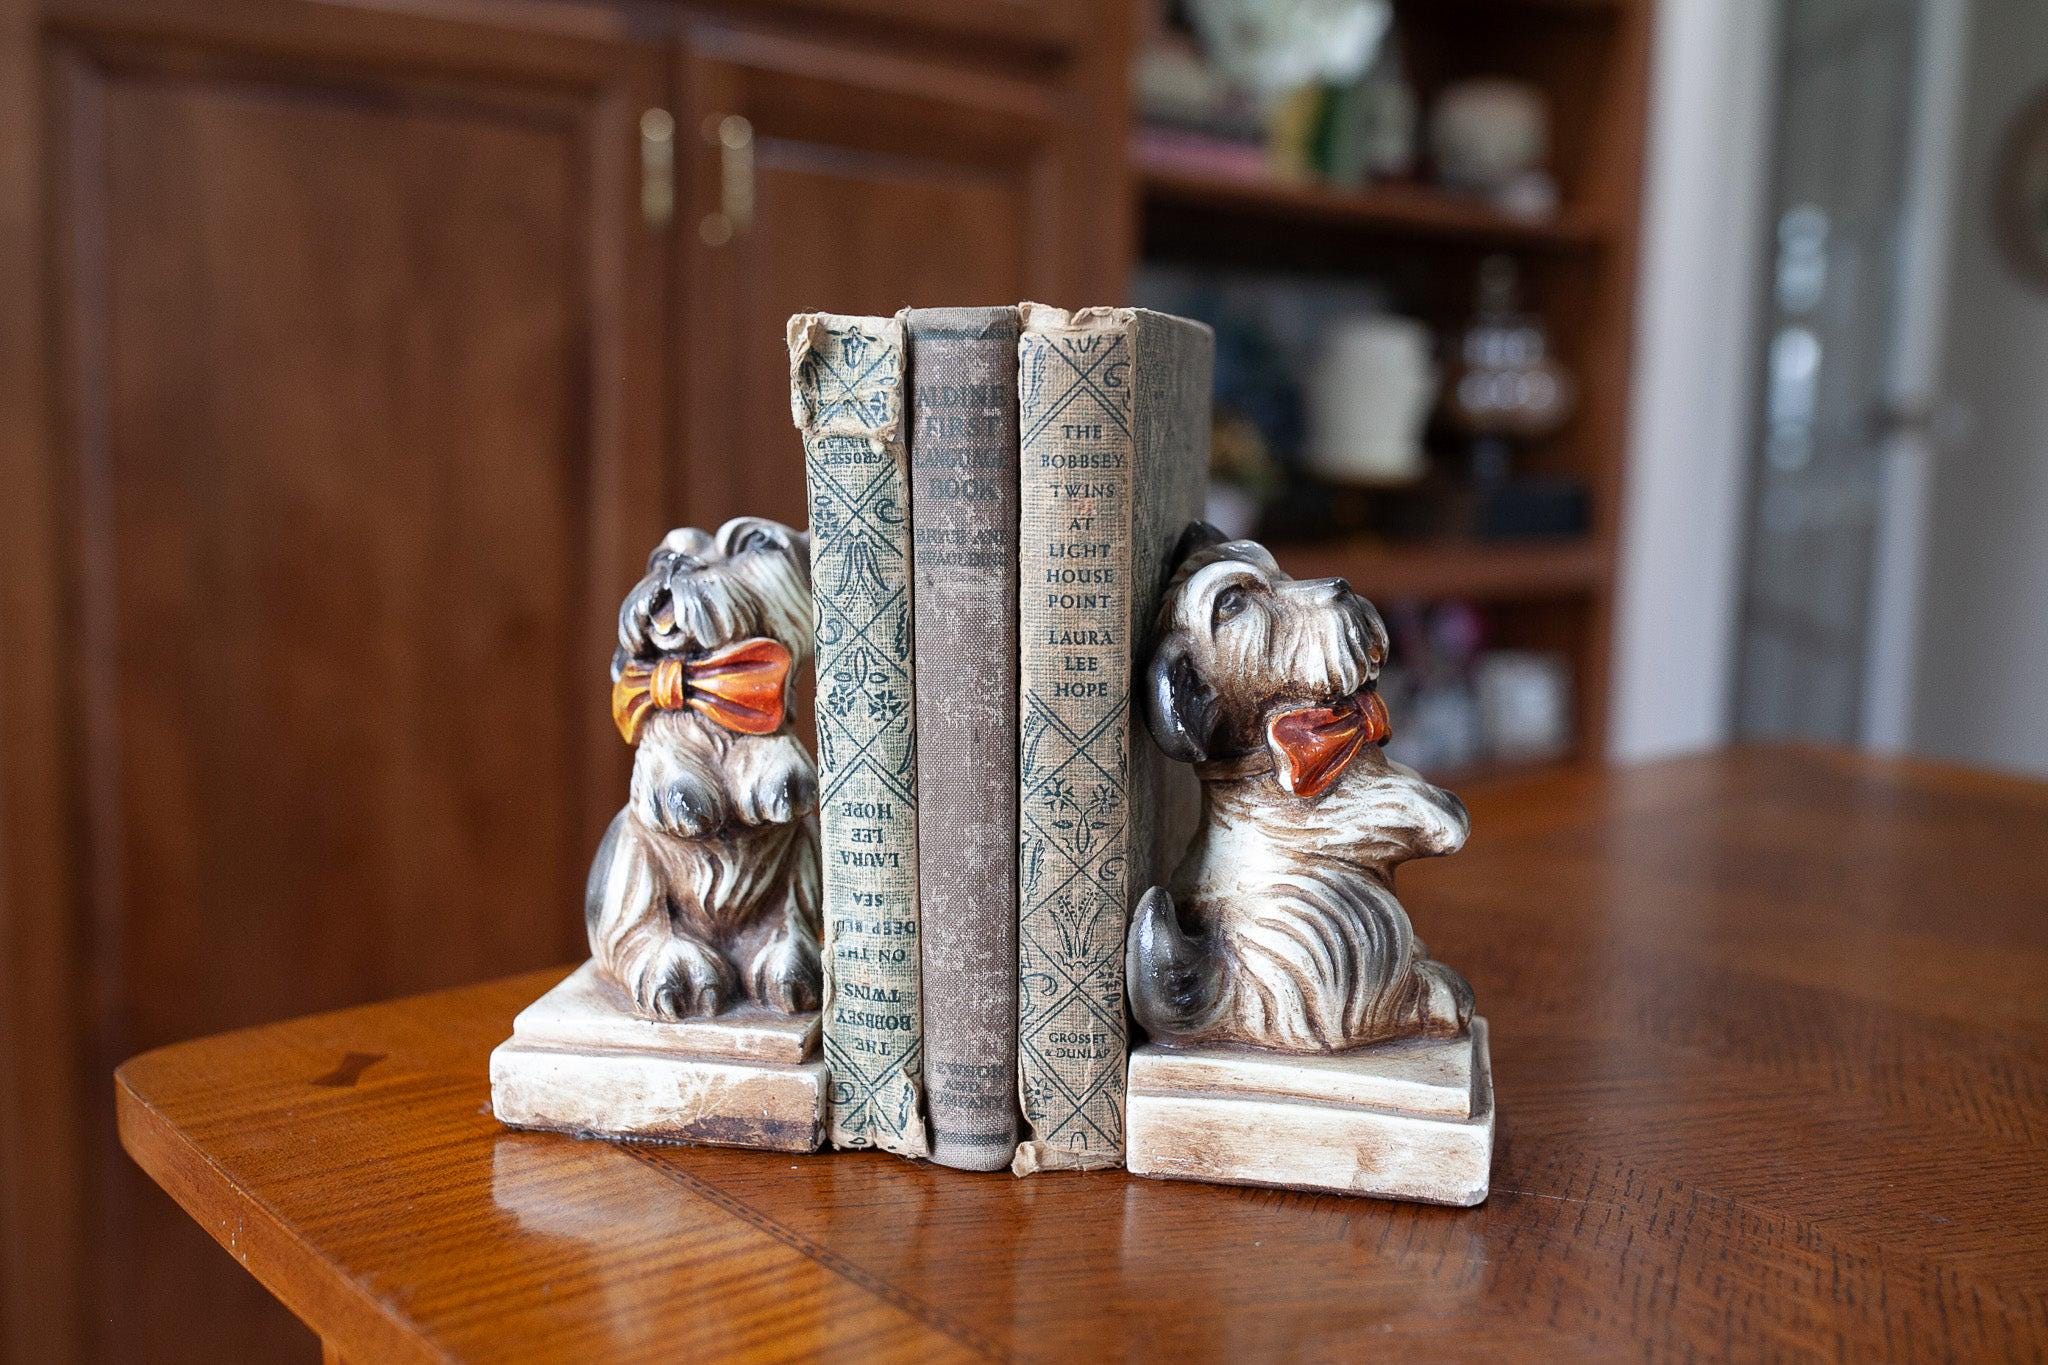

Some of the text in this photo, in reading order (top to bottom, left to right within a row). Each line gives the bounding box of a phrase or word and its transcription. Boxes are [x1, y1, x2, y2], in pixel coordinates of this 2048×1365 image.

[927, 416, 999, 438] FIRST
[1062, 424, 1103, 440] THE
[823, 452, 882, 465] GROSSET
[1041, 454, 1125, 469] BOBBSEY
[929, 478, 999, 500] BOOK
[1050, 483, 1116, 499] TWINS
[1069, 517, 1095, 532] AT
[1049, 543, 1111, 559] LIGHT
[1046, 568, 1115, 584] HOUSE
[1048, 594, 1111, 609] POINT
[1048, 630, 1113, 646] LAURA
[1063, 656, 1098, 671] LEE
[1054, 681, 1108, 698] HOPE
[842, 802, 894, 820] HOPE
[851, 828, 884, 843] LEE
[840, 851, 900, 868] LAURA
[852, 892, 883, 907] SEA
[872, 920, 916, 936] DEEP
[879, 948, 906, 963] ON
[844, 983, 901, 1003] TWINS
[836, 1007, 912, 1031] BOBBSEY
[1048, 1032, 1108, 1044] GROSSET
[855, 1037, 892, 1056] THE
[1044, 1048, 1111, 1059] & DUNLAP
